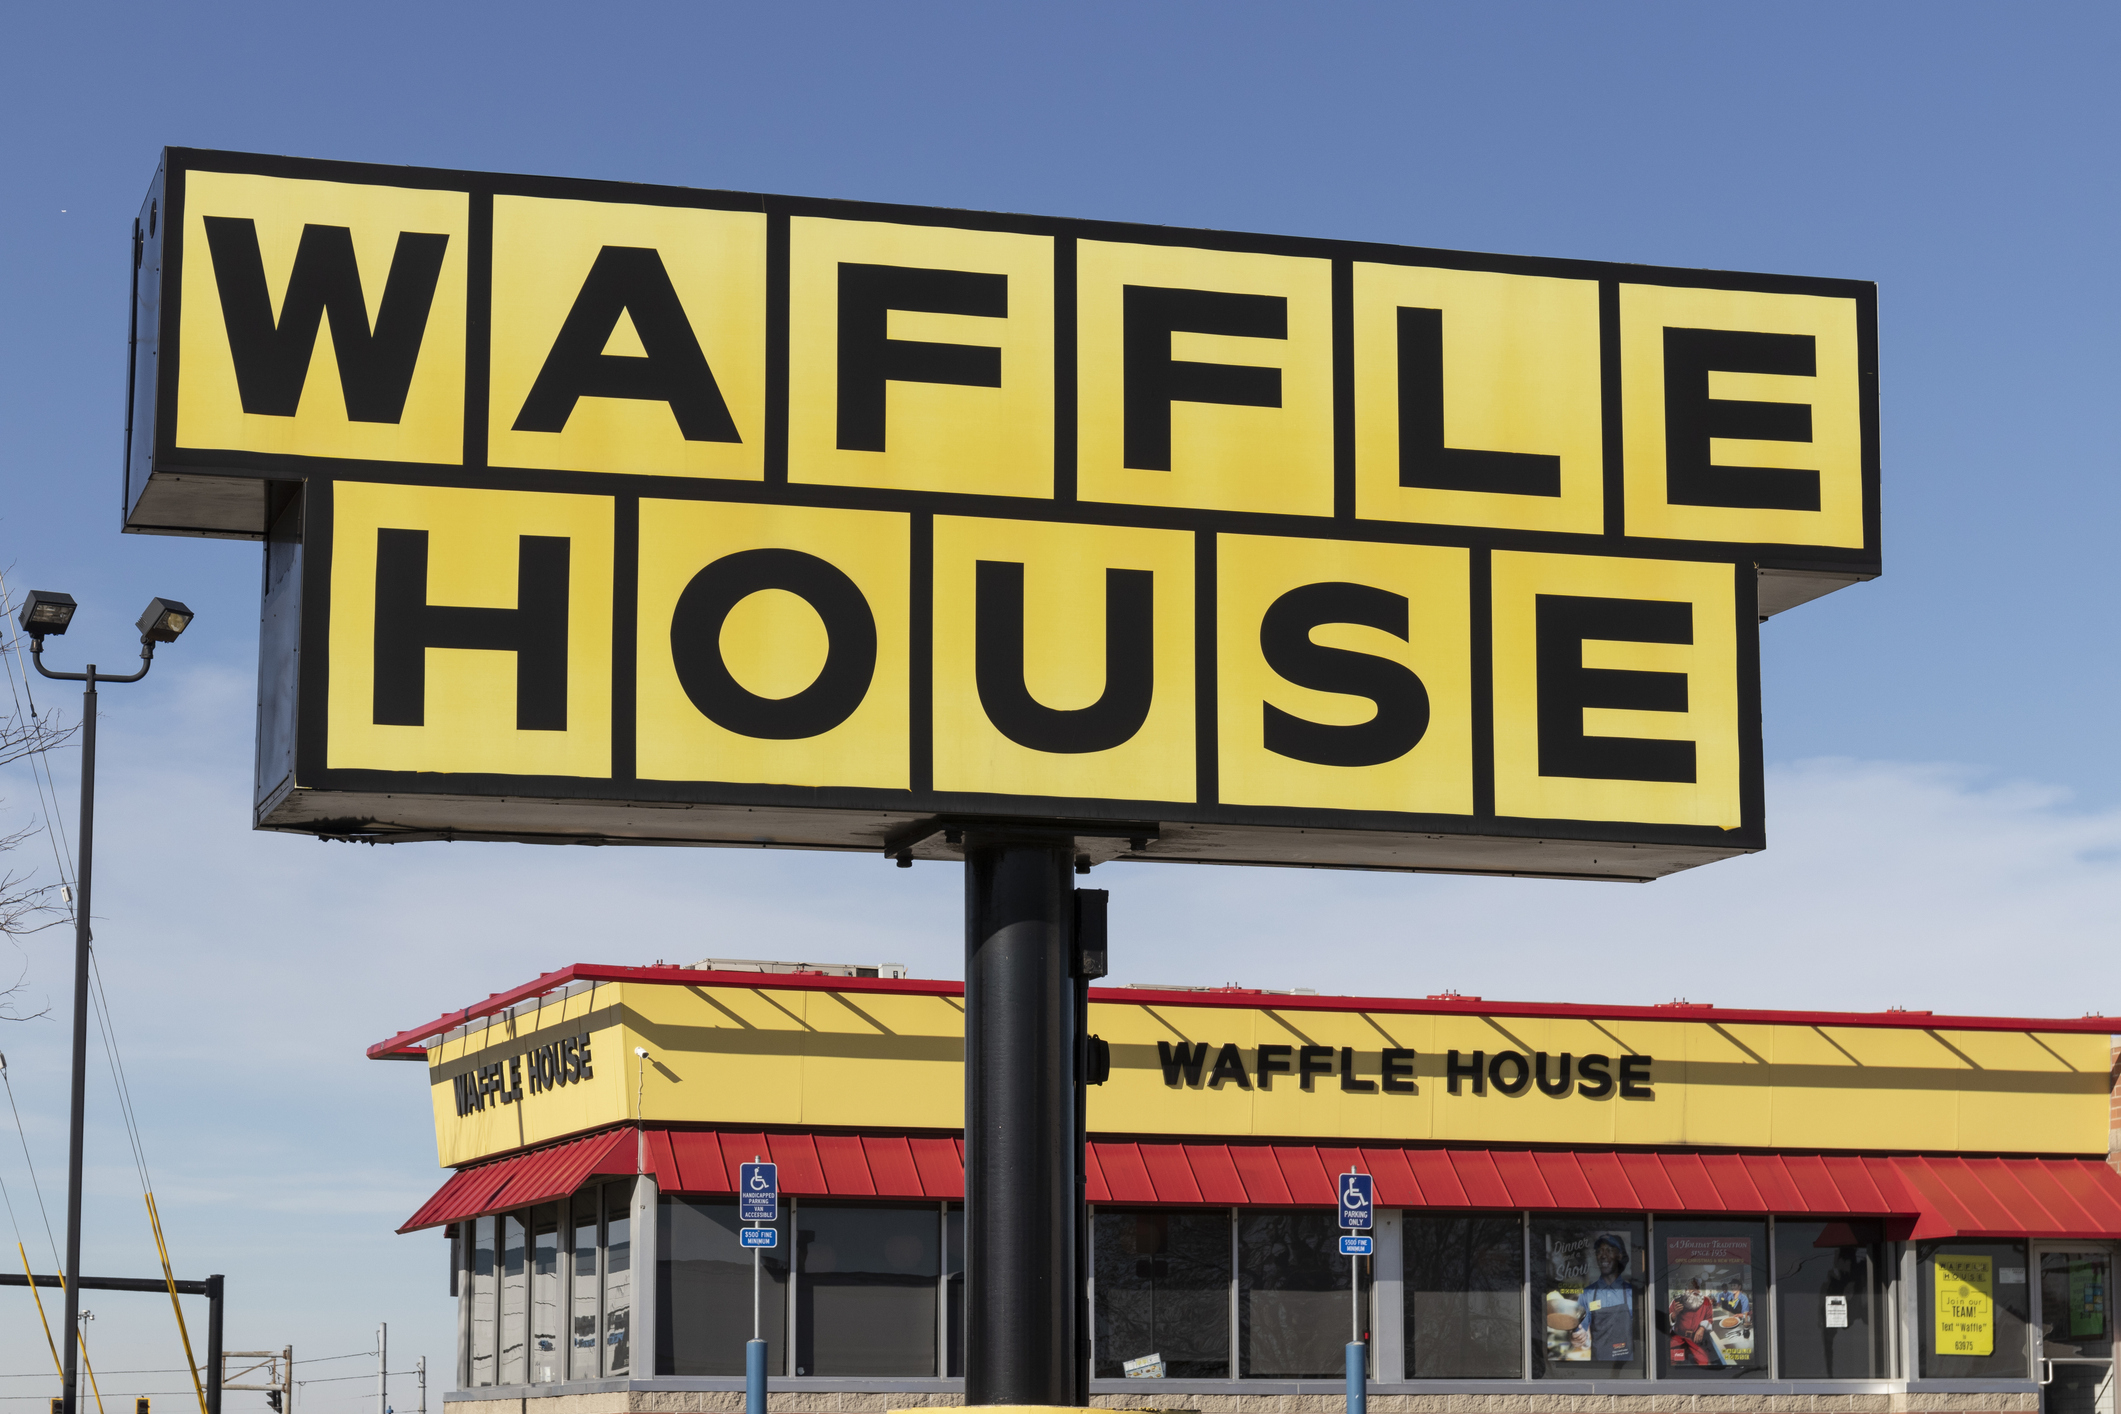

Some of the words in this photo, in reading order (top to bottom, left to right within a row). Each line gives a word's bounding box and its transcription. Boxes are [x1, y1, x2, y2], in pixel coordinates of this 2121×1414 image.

[202, 215, 1822, 512] WAFFLE
[372, 527, 1697, 784] HOUSE
[453, 1055, 523, 1117] WAFFLE
[527, 1032, 593, 1095] HOUSE
[1157, 1041, 1415, 1093] WAFFLE
[1446, 1049, 1653, 1099] HOUSE
[1344, 1210, 1368, 1218] PARKING
[1554, 1237, 1590, 1255] Dinner
[1711, 1249, 1727, 1257] 1955
[1554, 1261, 1590, 1281] Show
[1940, 1263, 1987, 1271] WAFFLE
[1944, 1272, 1983, 1280] HOUSE
[1946, 1297, 1965, 1305] Join
[1952, 1306, 1976, 1318] TEAM!
[1941, 1322, 1954, 1332] Text
